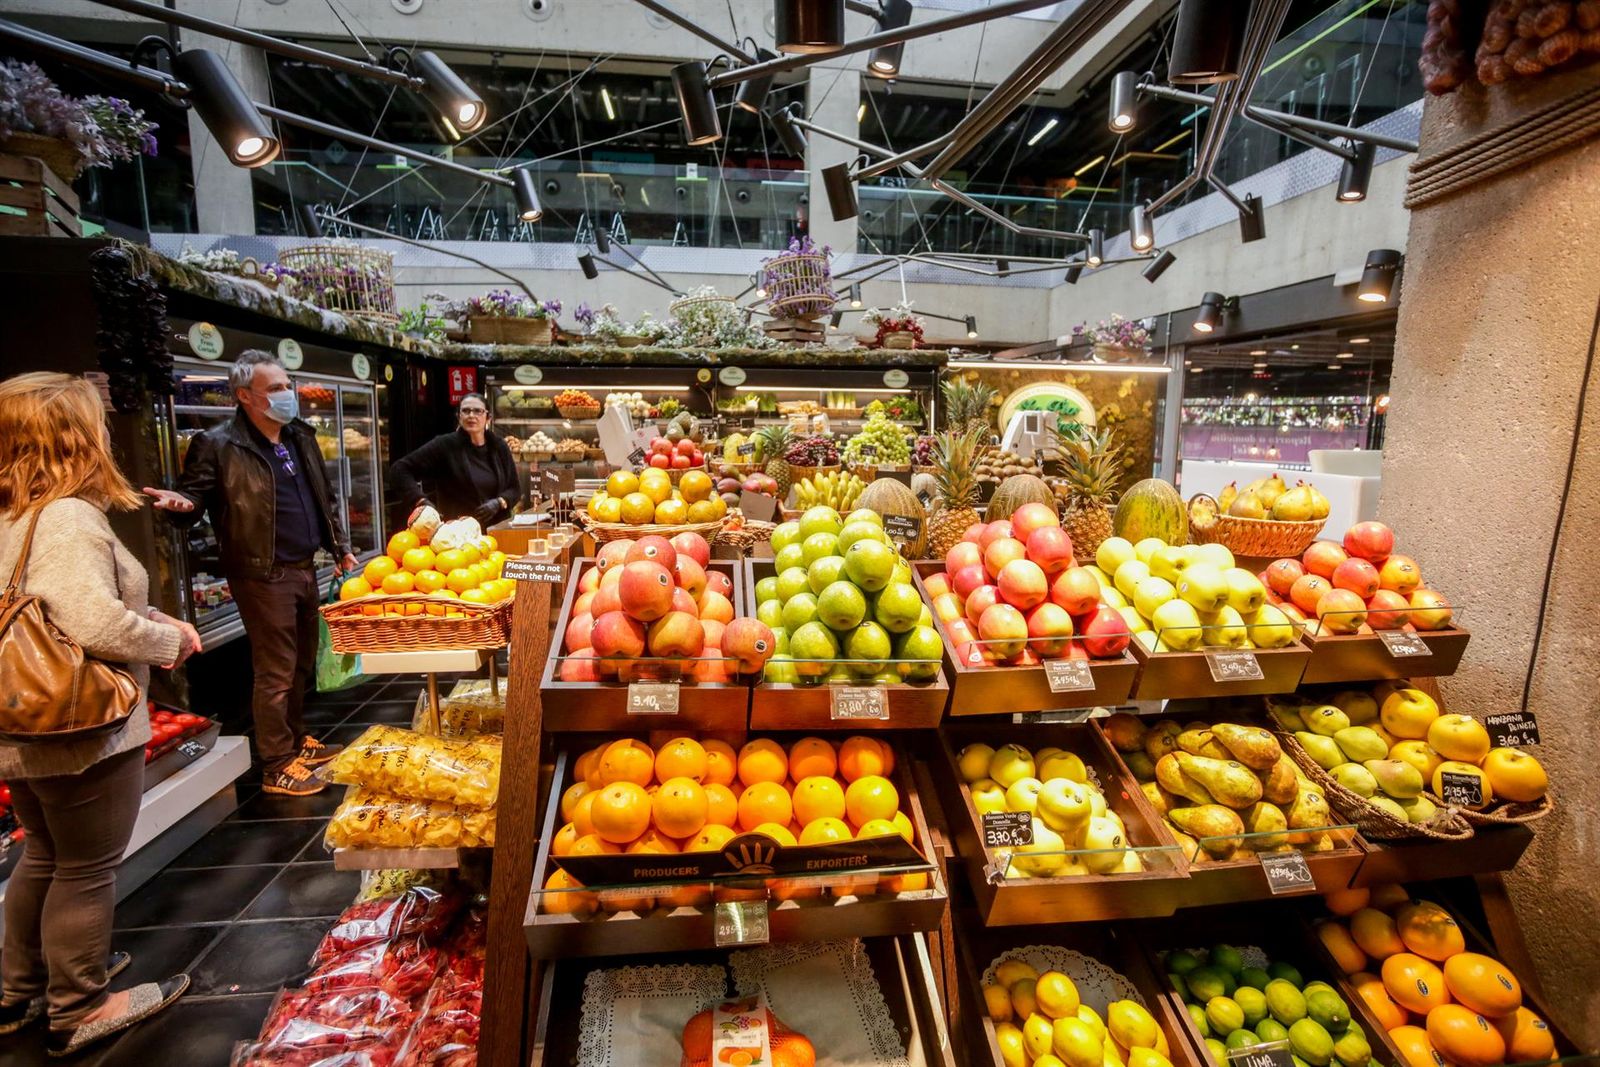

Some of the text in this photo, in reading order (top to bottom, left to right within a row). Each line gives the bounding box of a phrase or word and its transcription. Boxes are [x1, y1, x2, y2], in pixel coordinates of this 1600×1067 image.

[506, 562, 533, 571] Please,
[547, 565, 561, 573] not
[543, 574, 562, 582] fruit
[1487, 714, 1523, 725] MANZANA
[633, 855, 868, 878] PRODUCERS EXPORTERS
